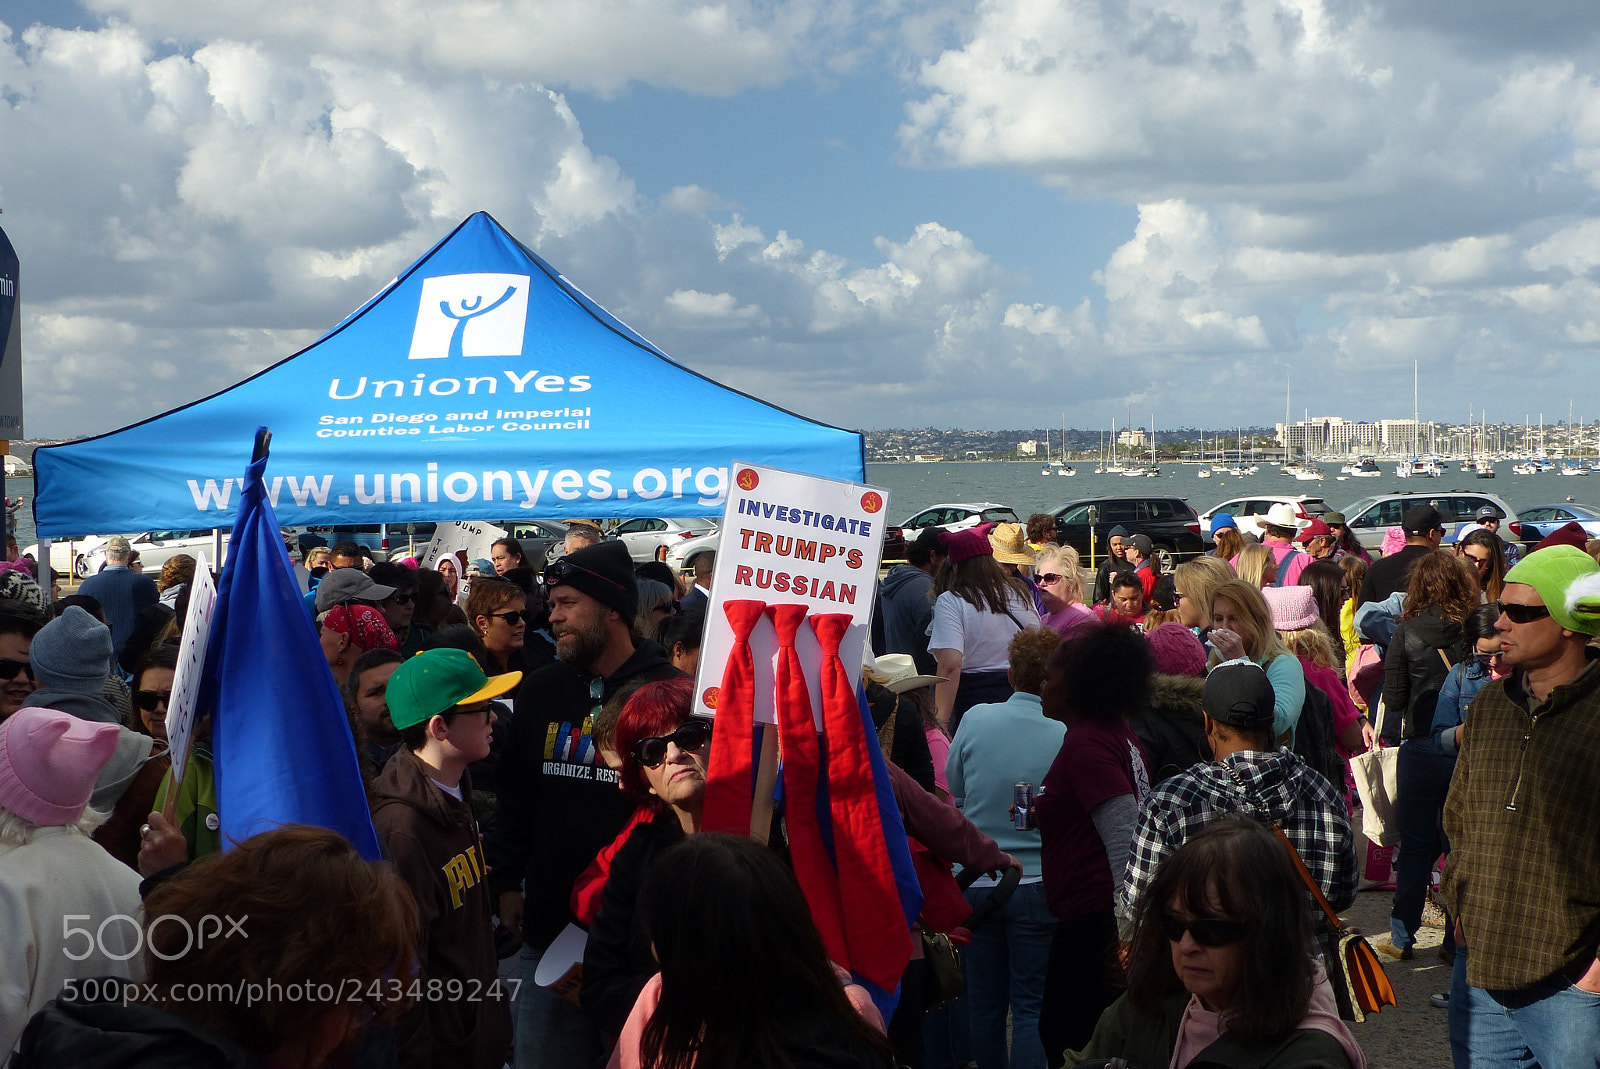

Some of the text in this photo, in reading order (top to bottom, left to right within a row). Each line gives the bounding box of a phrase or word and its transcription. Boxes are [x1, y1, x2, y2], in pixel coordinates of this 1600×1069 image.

[318, 407, 591, 425] San Diego and Imperial
[316, 419, 590, 438] Counties Labor Council
[738, 498, 872, 538] INVESTIGATE
[455, 520, 482, 536] DUMP
[428, 538, 442, 562] THE
[734, 564, 857, 605] RUSSIAN
[542, 761, 593, 779] ORGANIZE.
